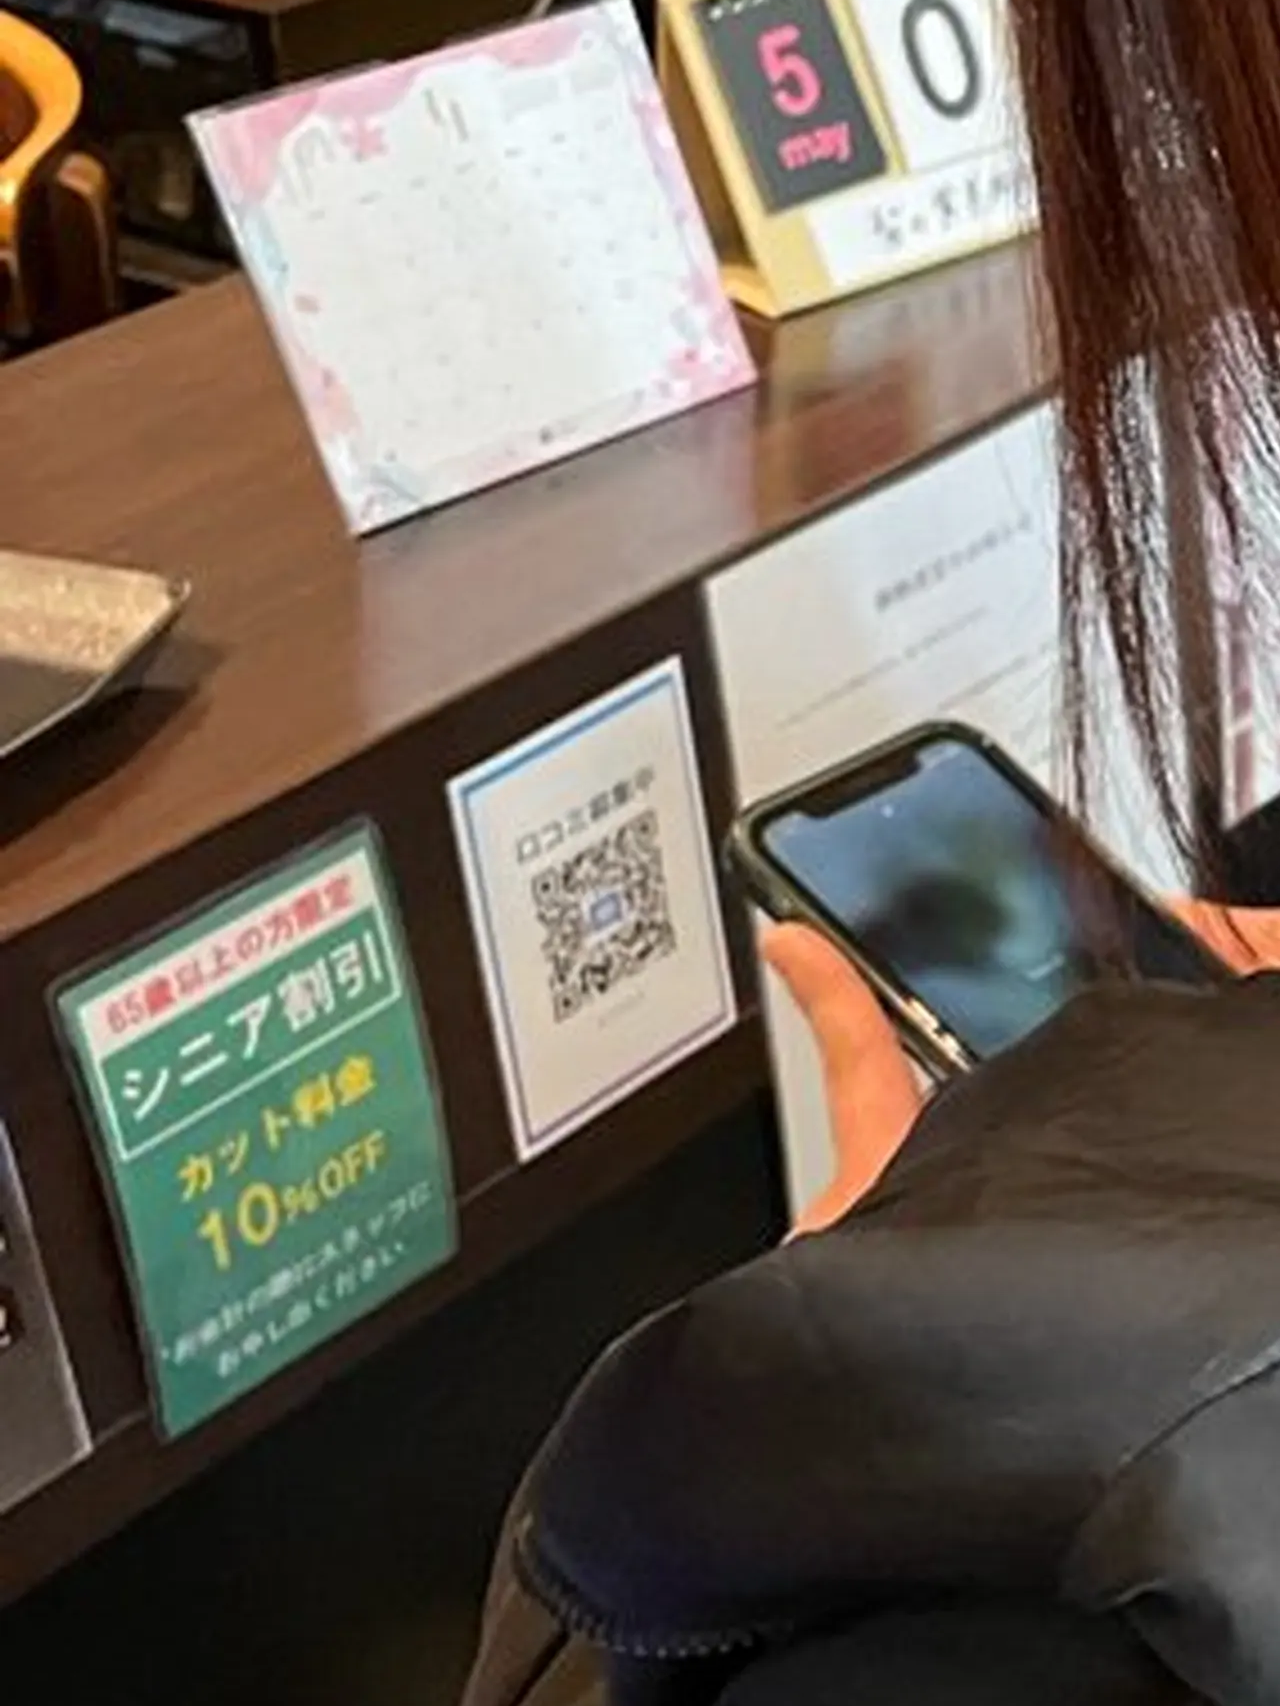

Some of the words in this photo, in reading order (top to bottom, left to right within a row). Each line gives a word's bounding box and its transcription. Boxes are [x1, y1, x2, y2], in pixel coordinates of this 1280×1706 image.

[759, 25, 821, 116] 5
[780, 123, 851, 169] may
[107, 873, 353, 1033] 65歳以上の方限定
[122, 933, 380, 1119] シニア割引
[177, 1053, 375, 1202] カット料金
[199, 1131, 384, 1270] 10%OFF
